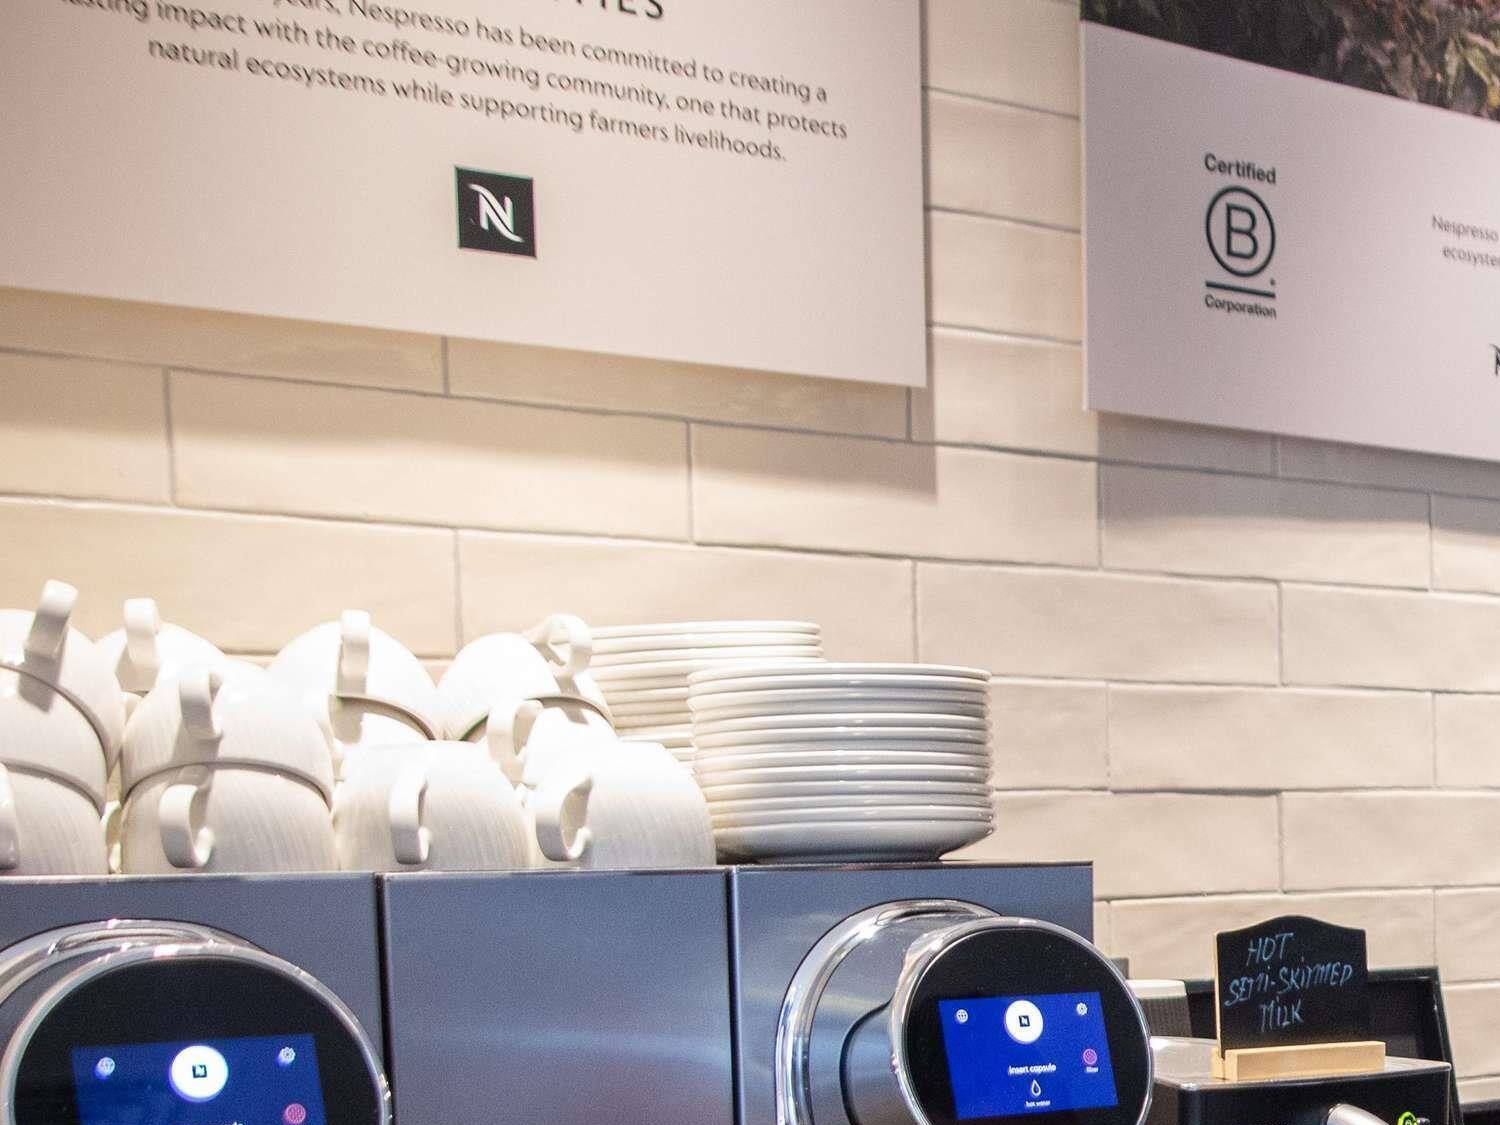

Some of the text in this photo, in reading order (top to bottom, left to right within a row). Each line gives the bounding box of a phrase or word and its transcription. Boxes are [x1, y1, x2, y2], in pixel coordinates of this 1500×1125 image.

[348, 0, 470, 37] Nespresso
[476, 18, 513, 47] has
[520, 25, 576, 57] been
[581, 43, 697, 80] committed
[703, 65, 725, 84] to
[729, 69, 811, 104] creating
[815, 86, 828, 103] a
[155, 1, 247, 36] impact
[252, 18, 309, 46] with
[315, 27, 357, 51] the
[361, 38, 541, 92] coffee-growing
[546, 71, 670, 112] community,
[676, 94, 715, 117] one
[720, 101, 761, 125] that
[767, 109, 848, 139] protects
[148, 38, 787, 162] natural ecosystems while supporting farmers livelihoods.
[1204, 153, 1277, 185] Certified
[1431, 214, 1499, 243] Nespresso
[1204, 294, 1277, 320] Corporation
[1245, 932, 1294, 967] HOT
